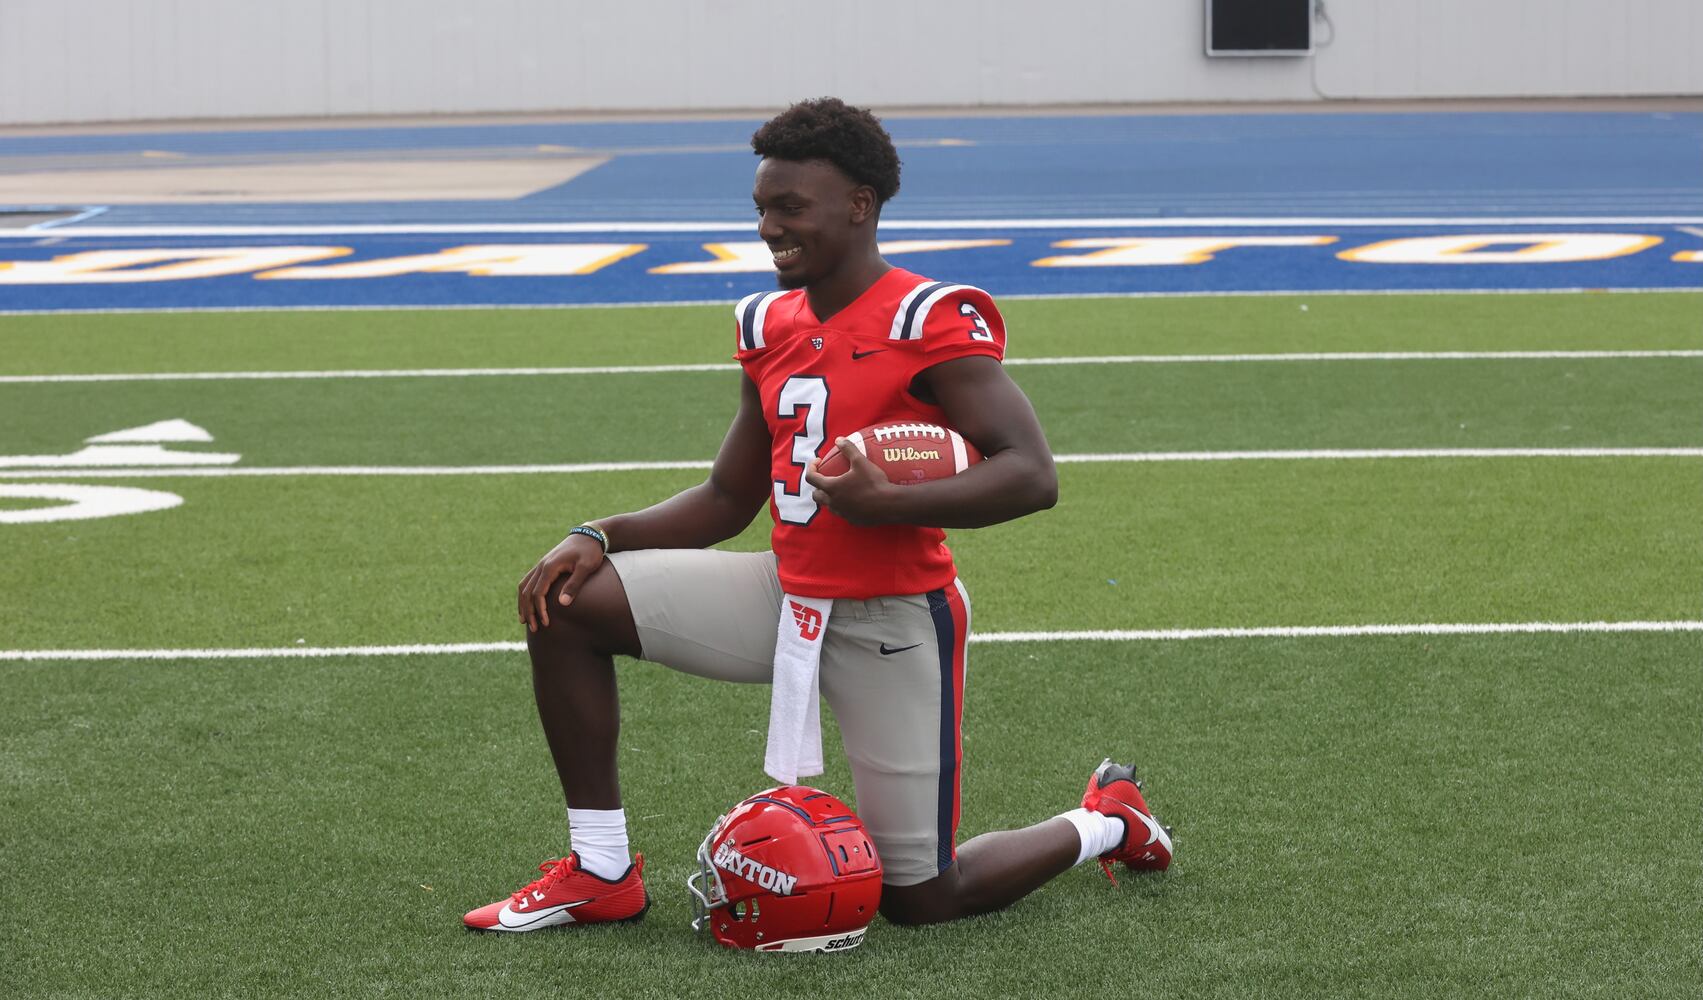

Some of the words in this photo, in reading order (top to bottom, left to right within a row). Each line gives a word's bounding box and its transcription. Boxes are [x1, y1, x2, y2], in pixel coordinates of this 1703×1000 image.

[0, 233, 1703, 285] DAYTO
[958, 302, 994, 343] 3
[774, 374, 831, 527] 3
[882, 447, 940, 461] Wilson
[713, 843, 797, 895] DAYTON
